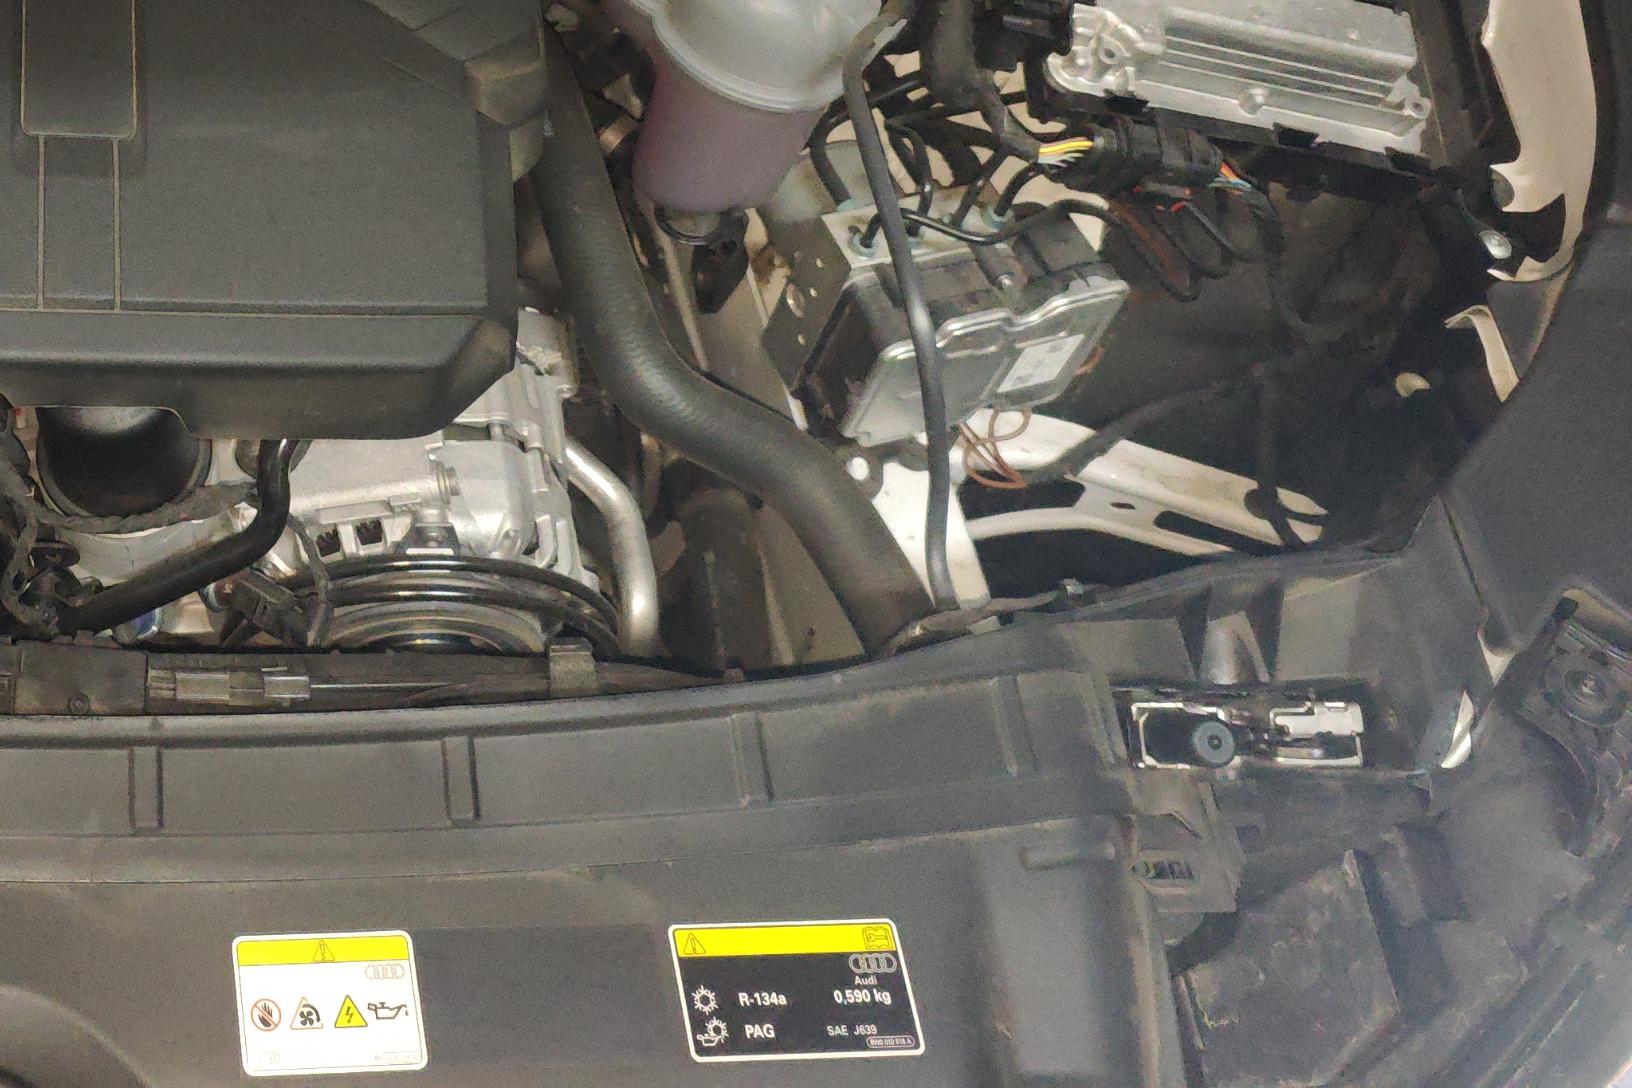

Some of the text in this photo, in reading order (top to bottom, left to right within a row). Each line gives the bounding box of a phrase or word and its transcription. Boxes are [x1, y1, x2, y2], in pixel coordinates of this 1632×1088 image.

[855, 975, 877, 985] Audi
[738, 988, 891, 1006] R-134a 0,590 kg
[744, 1024, 877, 1038] PAG SAE J639
